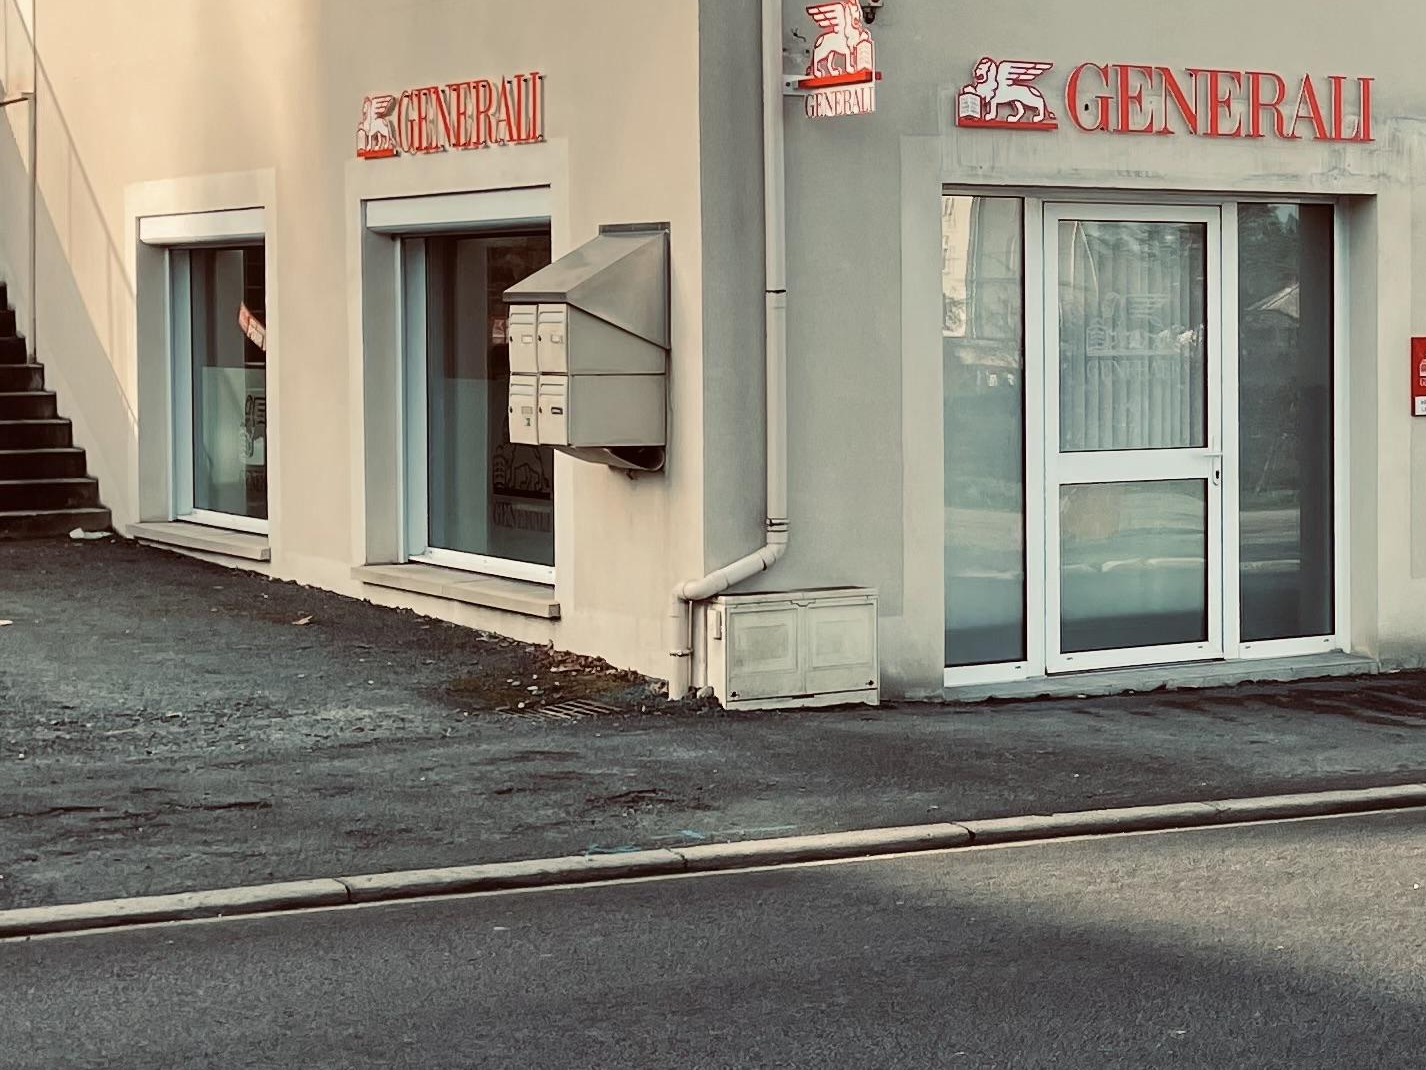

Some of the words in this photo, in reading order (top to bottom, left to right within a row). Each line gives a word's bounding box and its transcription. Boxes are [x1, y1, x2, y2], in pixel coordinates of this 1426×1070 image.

[397, 72, 546, 155] GENERALI
[805, 86, 874, 119] GENERALI
[1065, 62, 1375, 143] GENERALI
